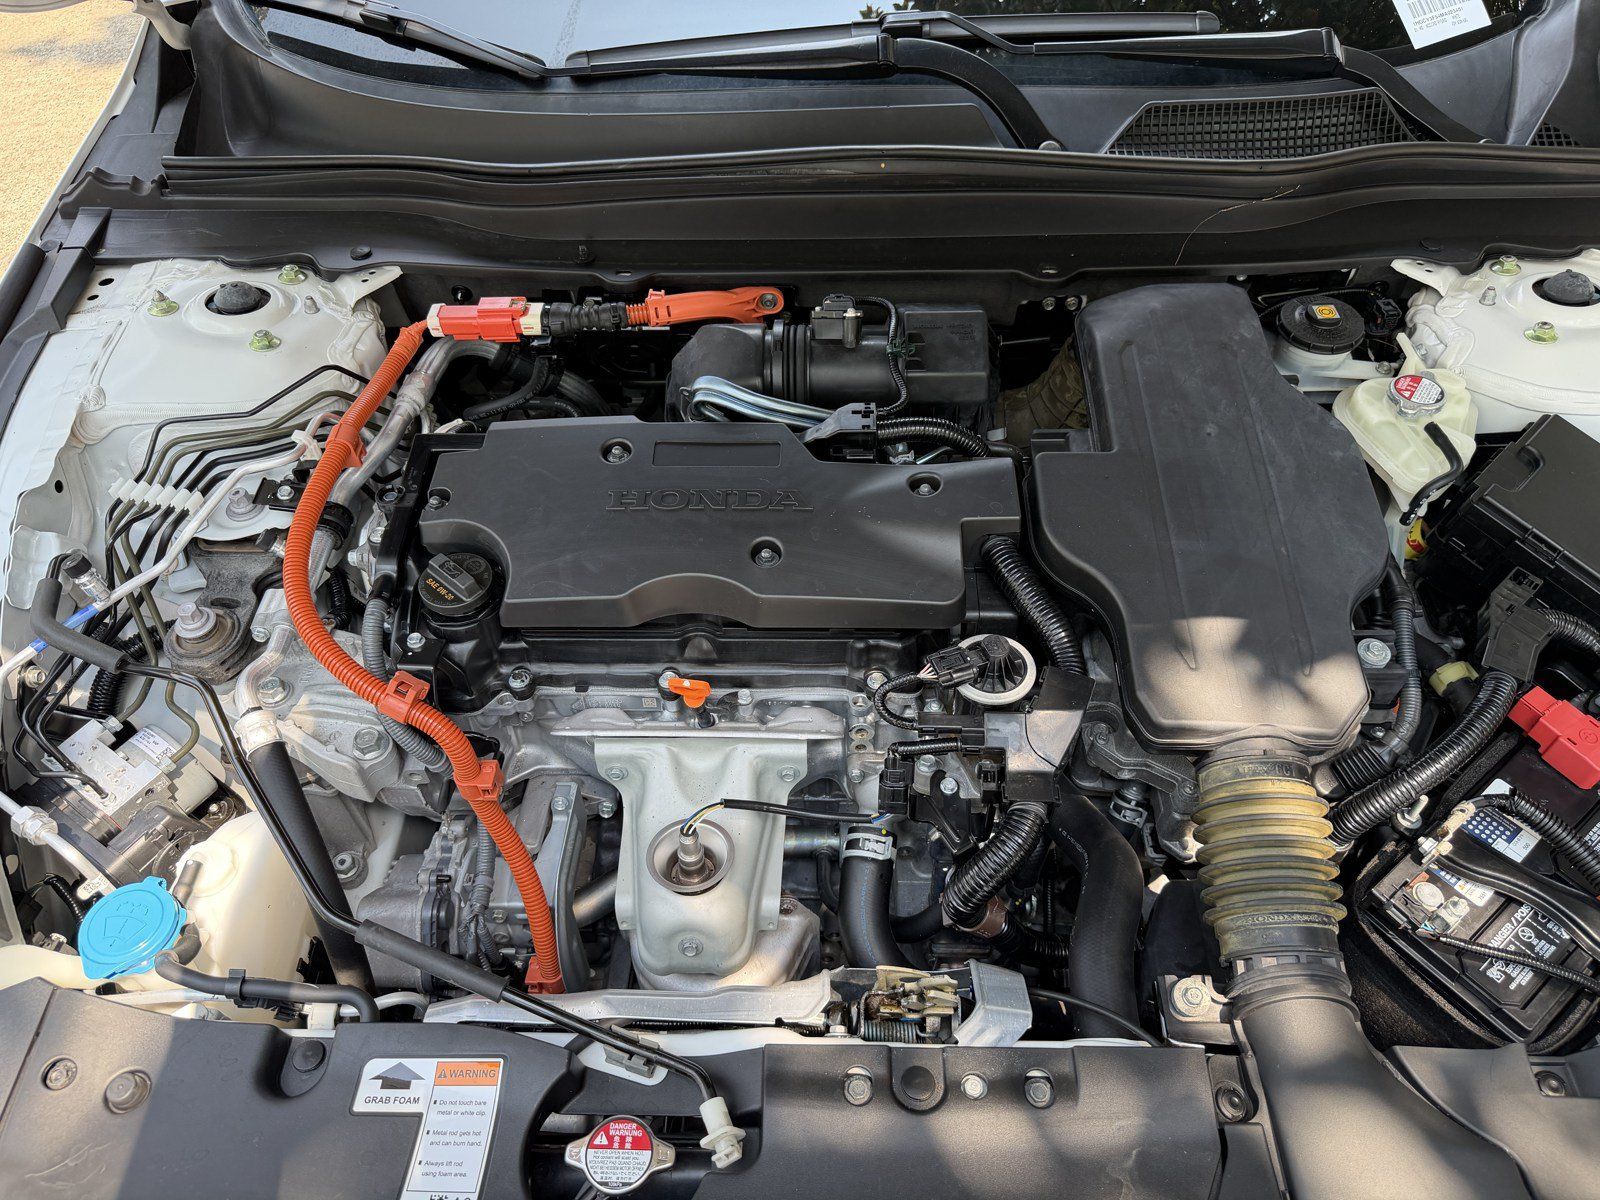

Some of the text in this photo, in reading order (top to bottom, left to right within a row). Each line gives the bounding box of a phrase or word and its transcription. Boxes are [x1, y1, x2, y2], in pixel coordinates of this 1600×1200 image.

[605, 488, 814, 510] HONDA
[426, 578, 440, 589] SAE
[450, 1069, 496, 1078] WARNING
[364, 1096, 420, 1104] GRAB FOAM
